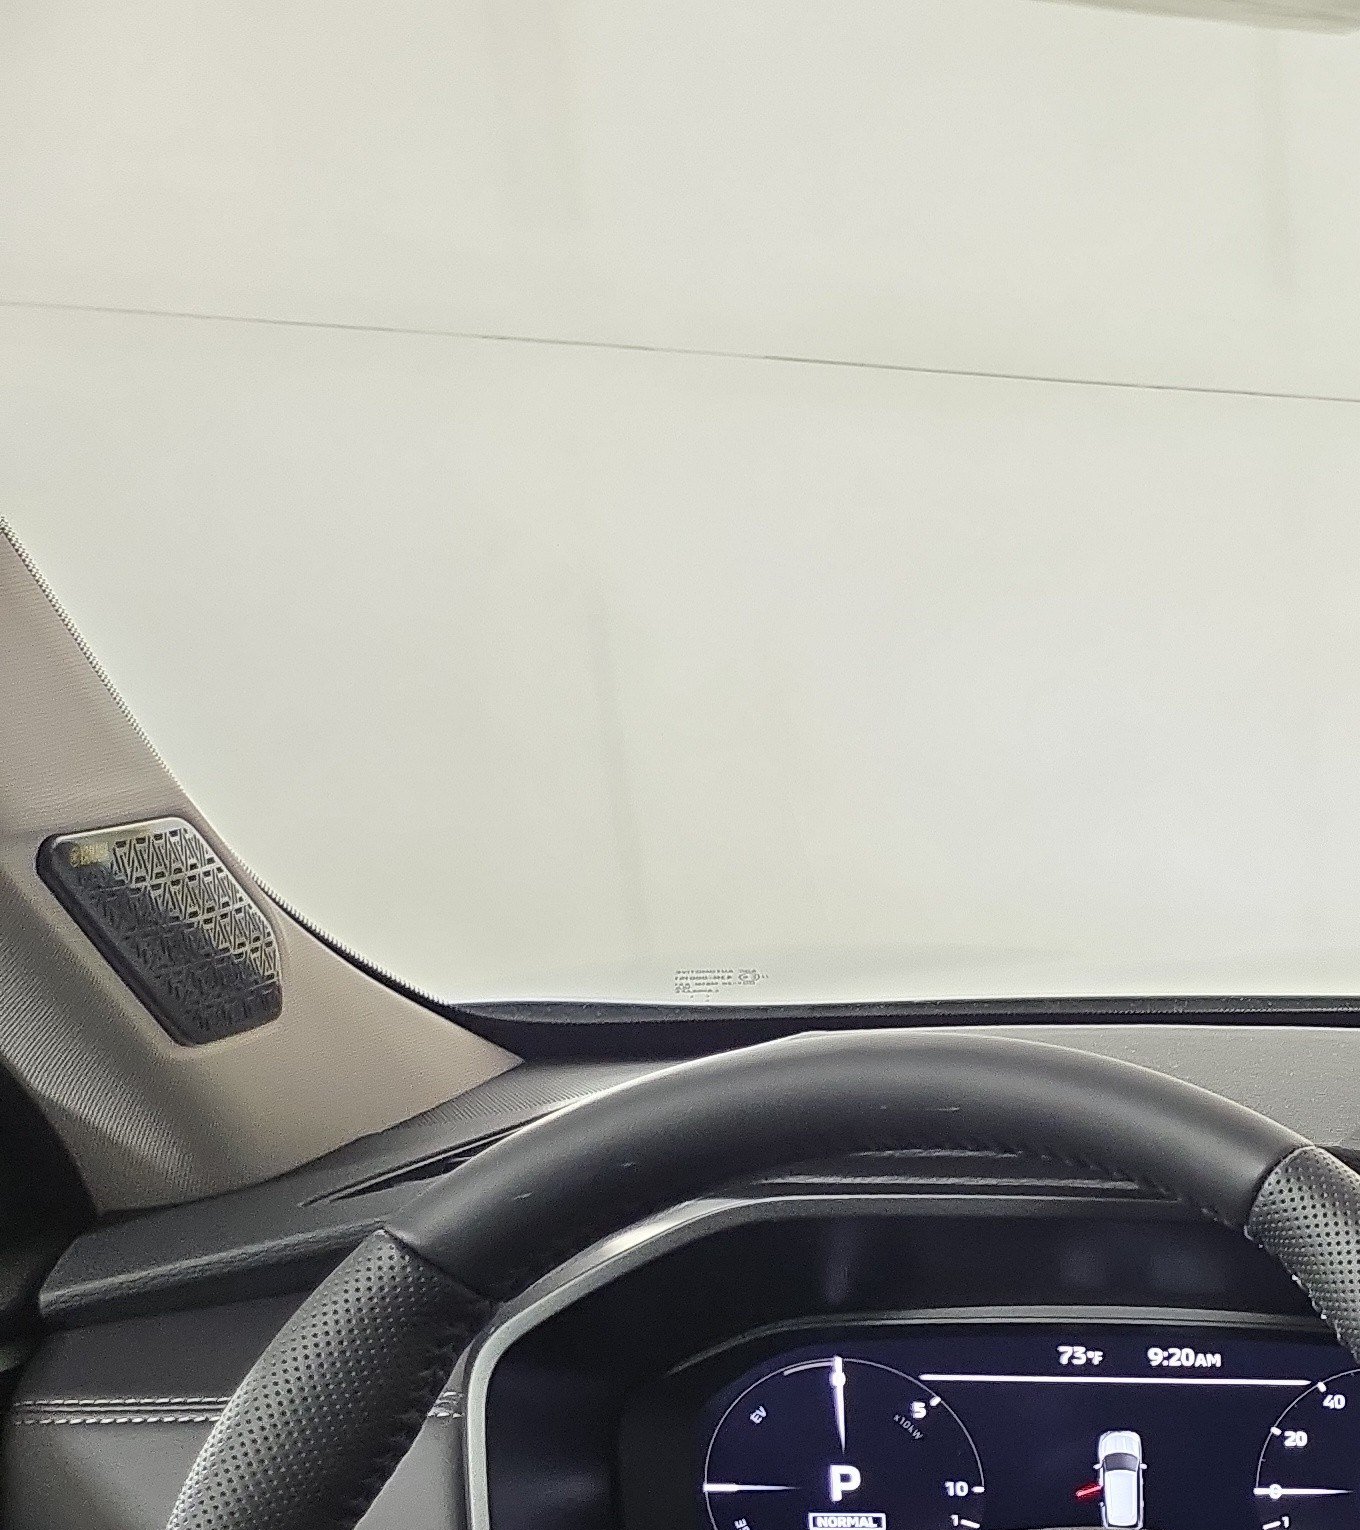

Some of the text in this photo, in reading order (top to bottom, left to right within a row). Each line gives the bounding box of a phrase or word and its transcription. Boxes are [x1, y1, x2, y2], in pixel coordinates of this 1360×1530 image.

[1057, 1346, 1104, 1366] 73°F
[1147, 1348, 1222, 1368] 9:20AM
[911, 1401, 927, 1419] 5
[1322, 1394, 1346, 1410] 40
[1284, 1430, 1308, 1447] 20
[829, 1465, 862, 1502] P
[945, 1481, 969, 1497] 10
[816, 1516, 878, 1530] NORMAL
